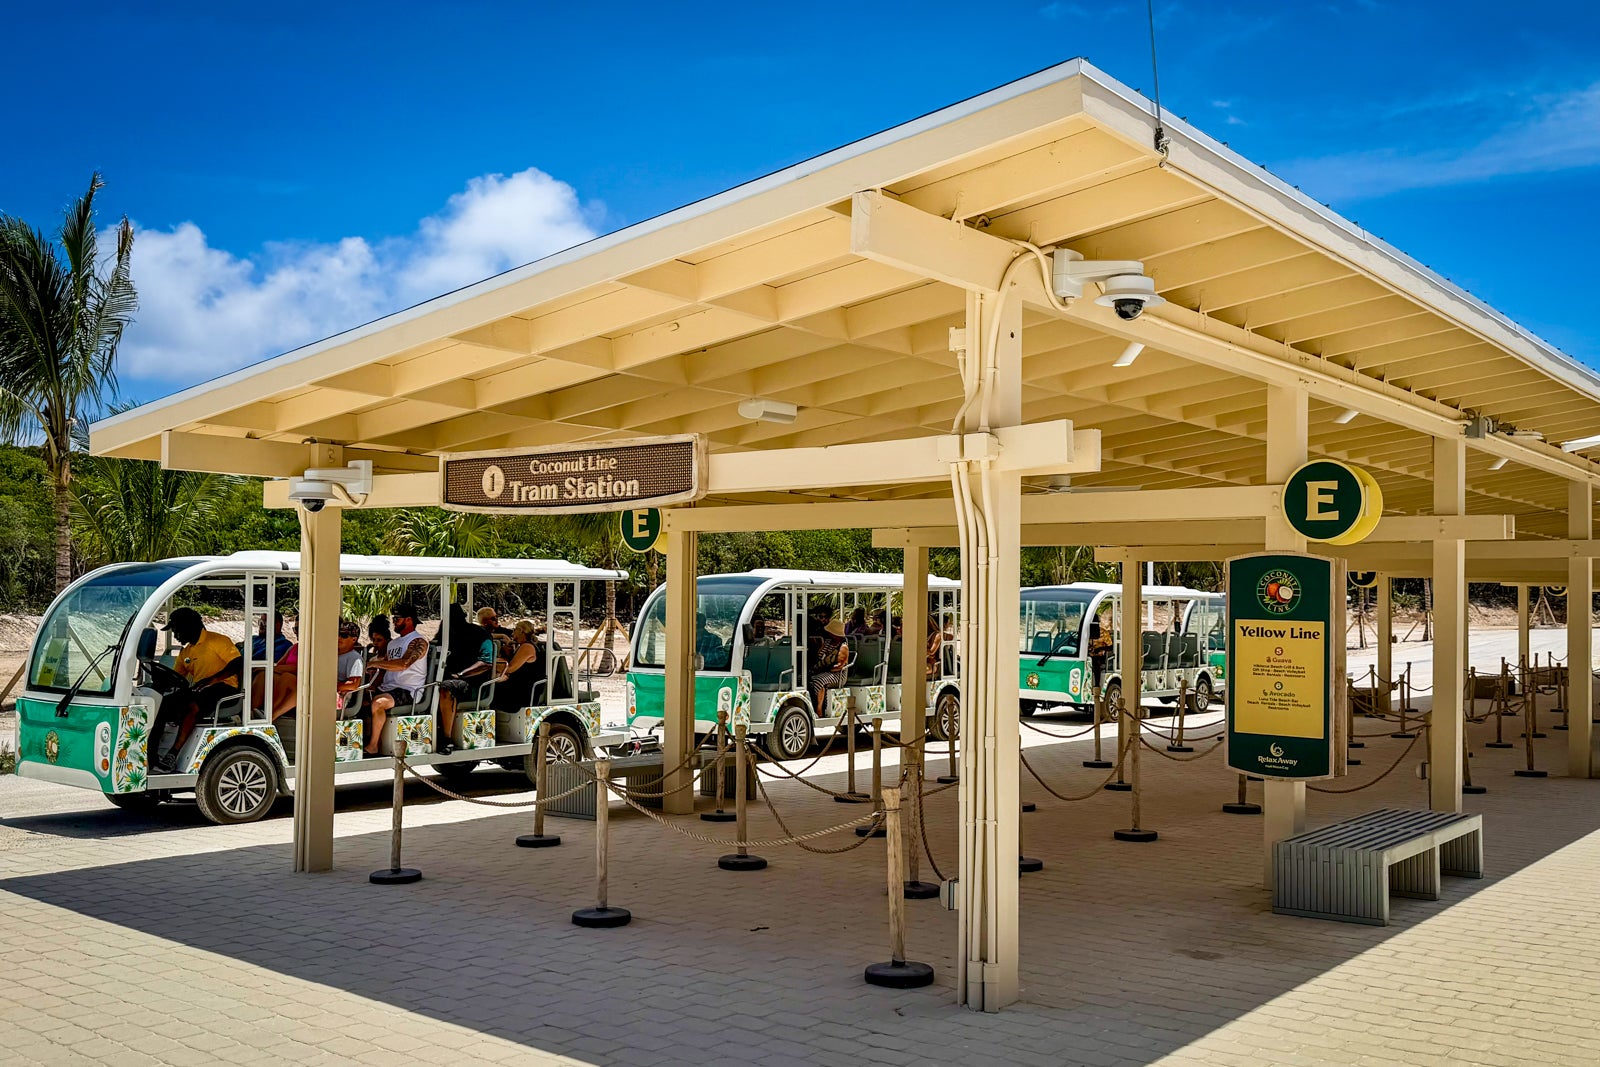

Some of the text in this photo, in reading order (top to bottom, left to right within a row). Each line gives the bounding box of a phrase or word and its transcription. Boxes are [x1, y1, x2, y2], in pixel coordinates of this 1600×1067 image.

[529, 454, 618, 475] Coconut Line
[489, 472, 496, 492] 1
[510, 474, 640, 502] Tram Station
[1305, 480, 1340, 521] E
[632, 508, 650, 539] E
[1260, 571, 1298, 587] COCONUT
[1267, 604, 1291, 613] LINE
[1240, 626, 1321, 640] Yellow Line
[1269, 690, 1296, 698] Avocado
